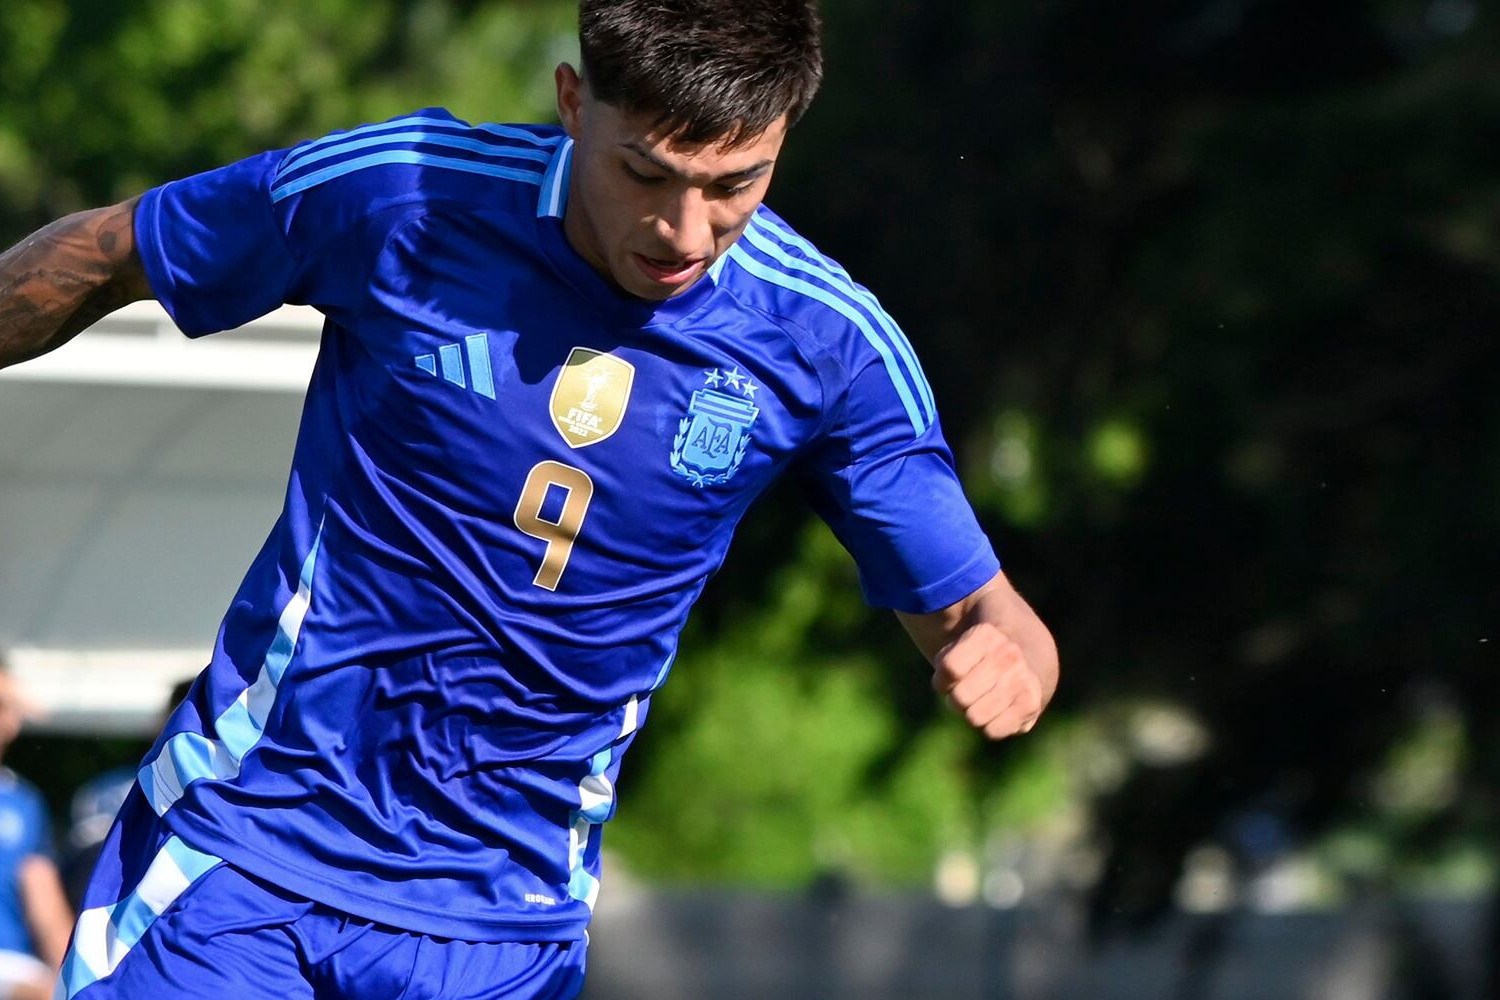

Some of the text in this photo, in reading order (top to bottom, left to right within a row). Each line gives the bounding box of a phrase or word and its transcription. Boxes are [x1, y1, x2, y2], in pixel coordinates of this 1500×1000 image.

[567, 407, 598, 428] FIFA
[691, 416, 734, 459] AFA
[513, 460, 594, 592] 9
